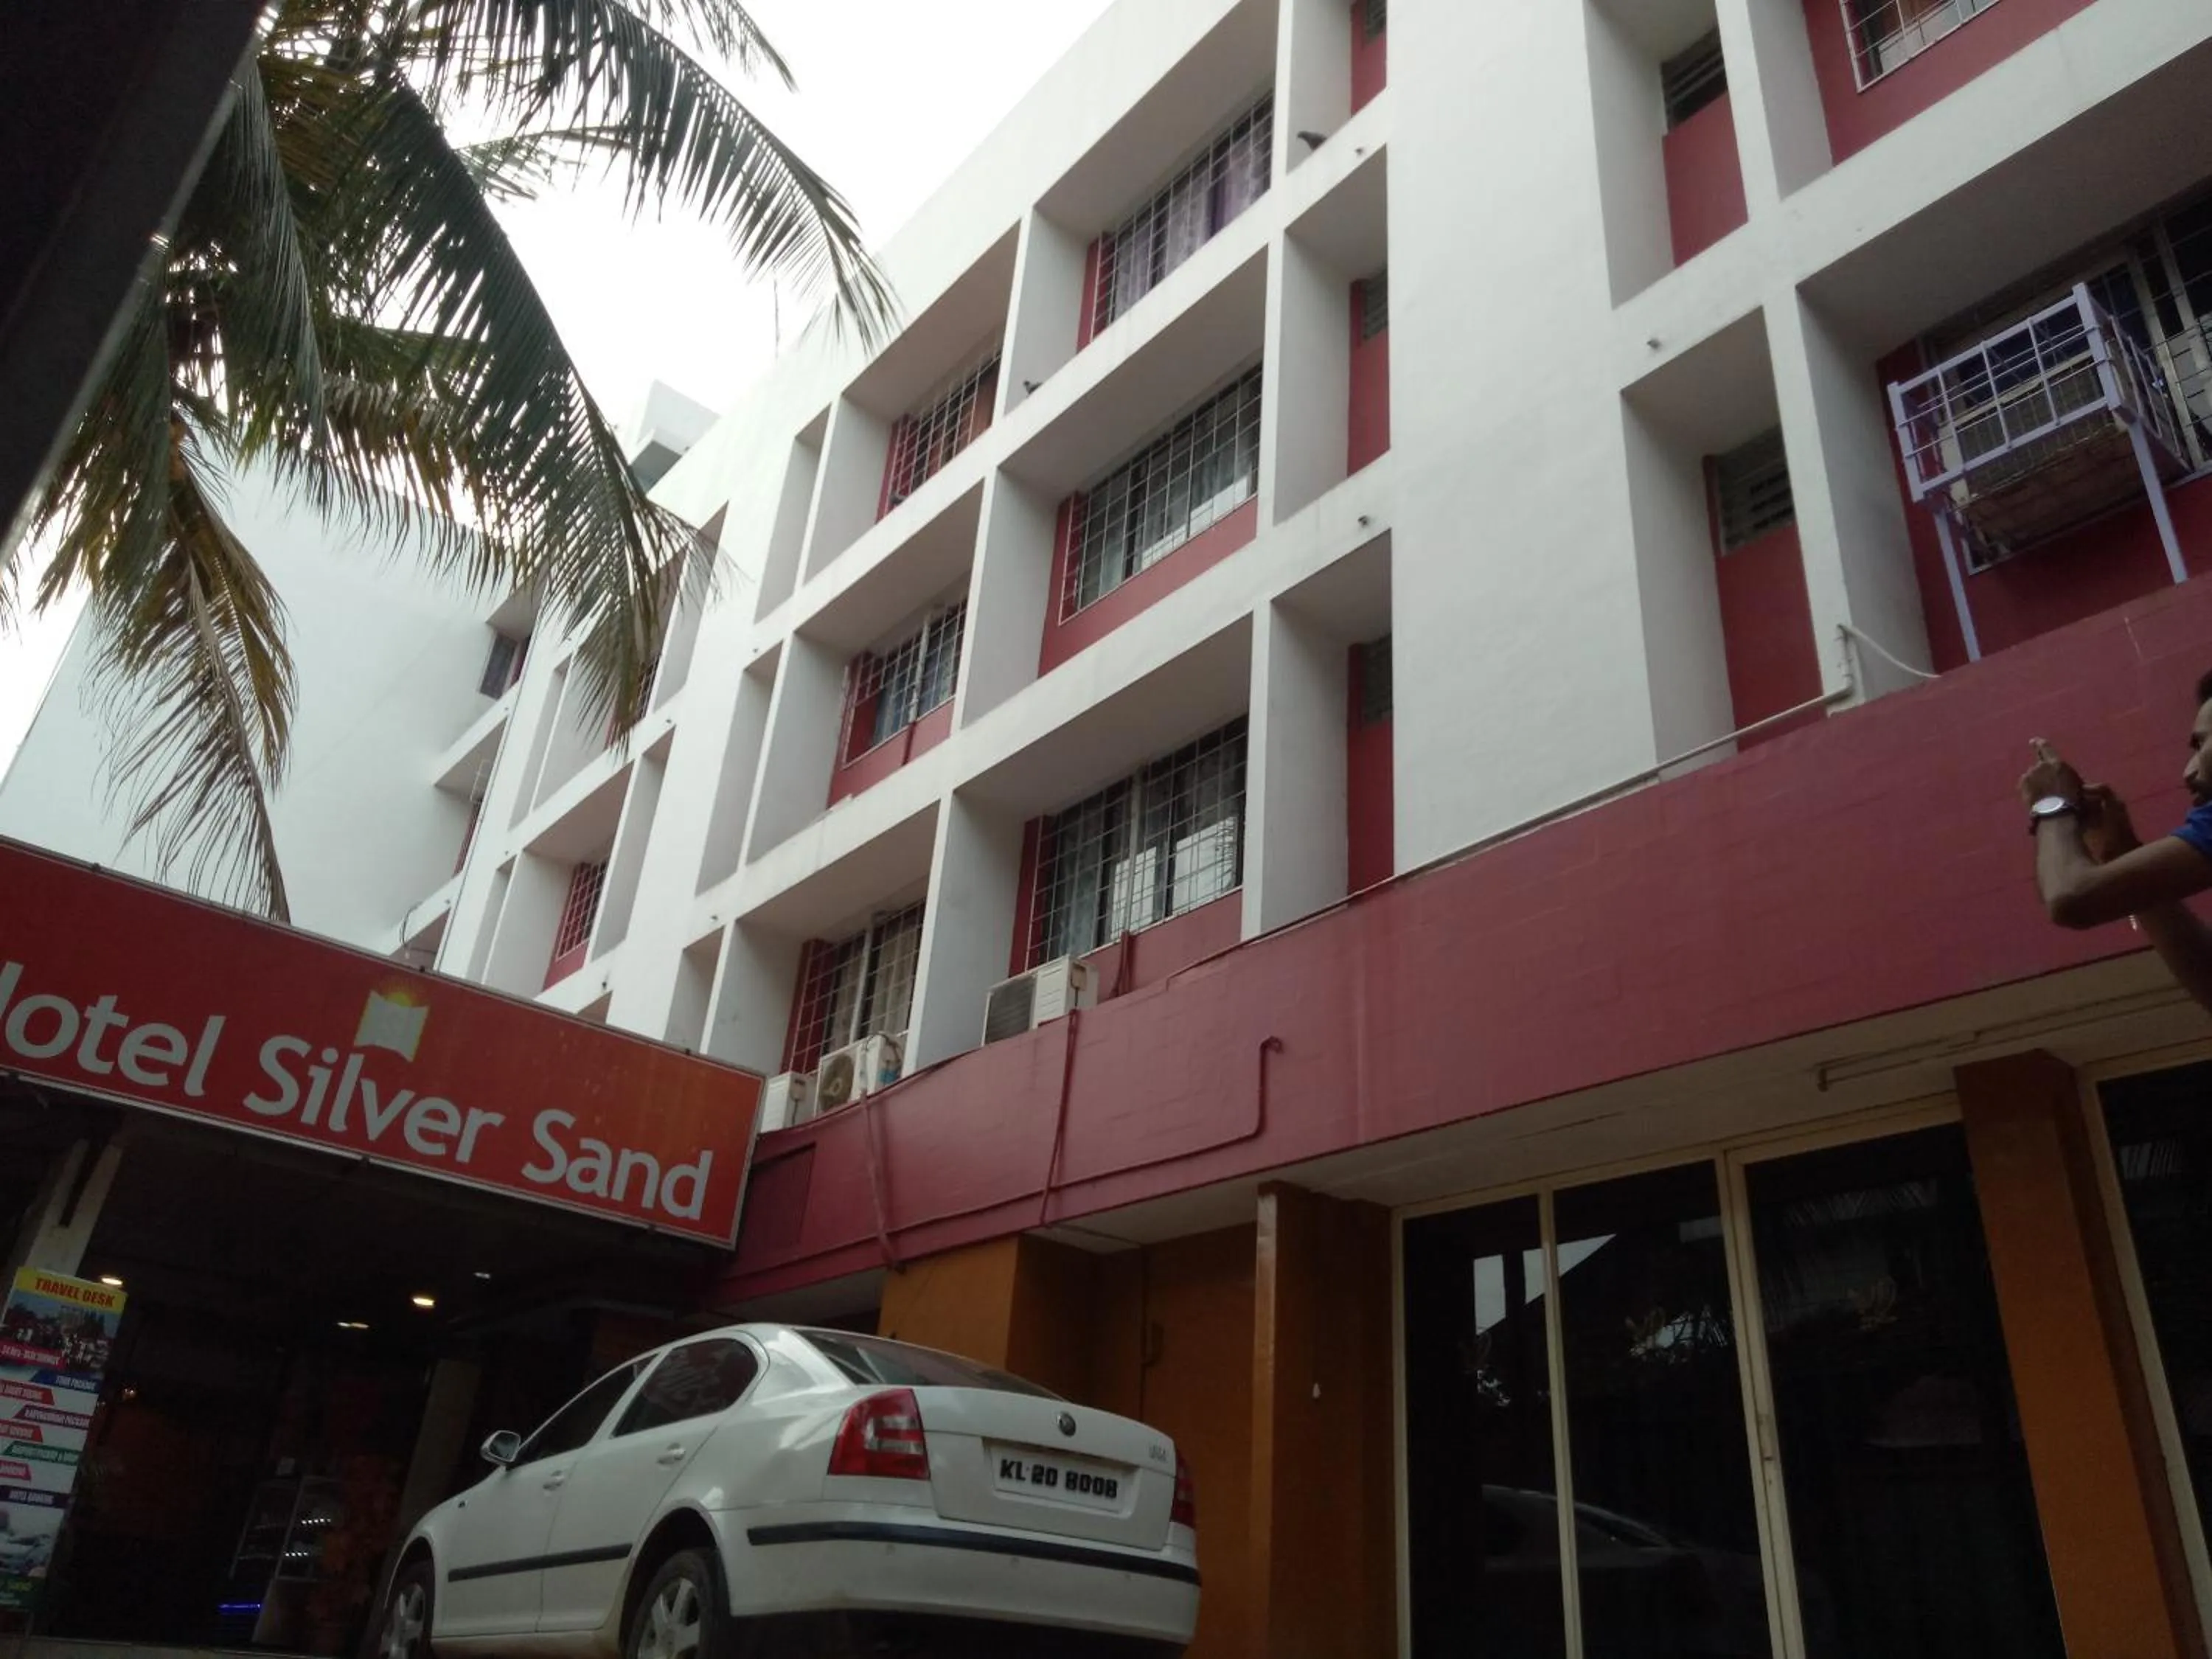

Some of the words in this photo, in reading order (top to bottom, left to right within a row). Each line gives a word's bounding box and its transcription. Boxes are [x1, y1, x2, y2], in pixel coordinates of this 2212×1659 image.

[243, 1035, 505, 1164] Silver
[521, 1108, 713, 1220] Sand
[35, 1277, 80, 1301] TRAVEL
[82, 1290, 116, 1308] DESK
[1000, 1458, 1026, 1481] KL
